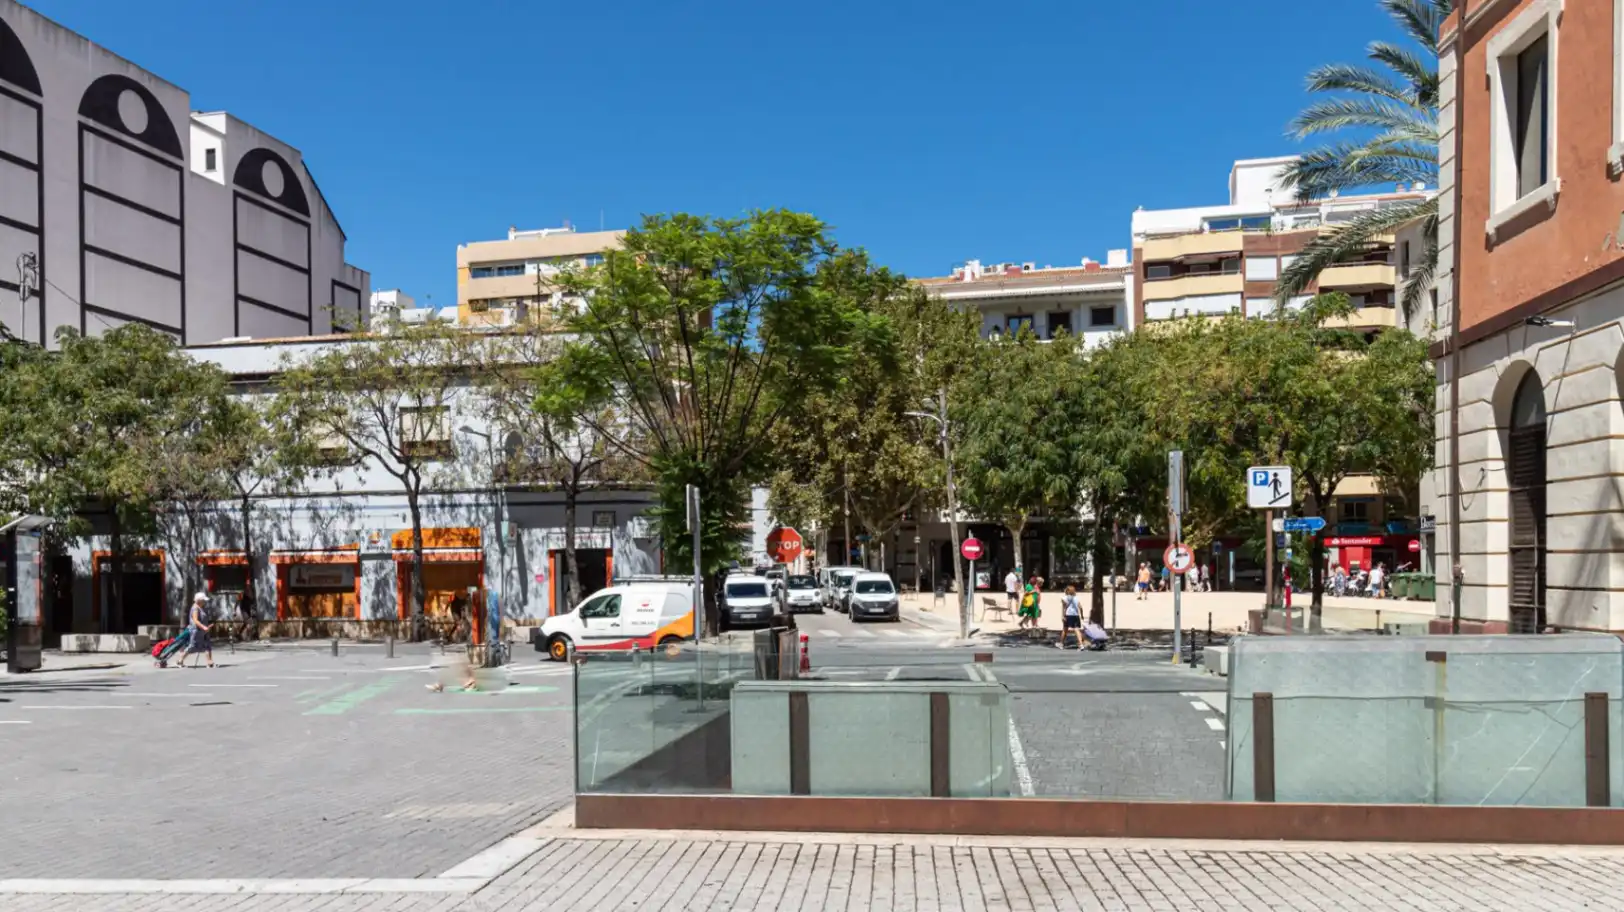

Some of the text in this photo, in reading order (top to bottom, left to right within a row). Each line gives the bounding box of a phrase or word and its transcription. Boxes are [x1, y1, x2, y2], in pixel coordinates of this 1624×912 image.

[1256, 472, 1266, 484] P
[769, 541, 800, 550] TOP
[1340, 537, 1372, 545] Santander
